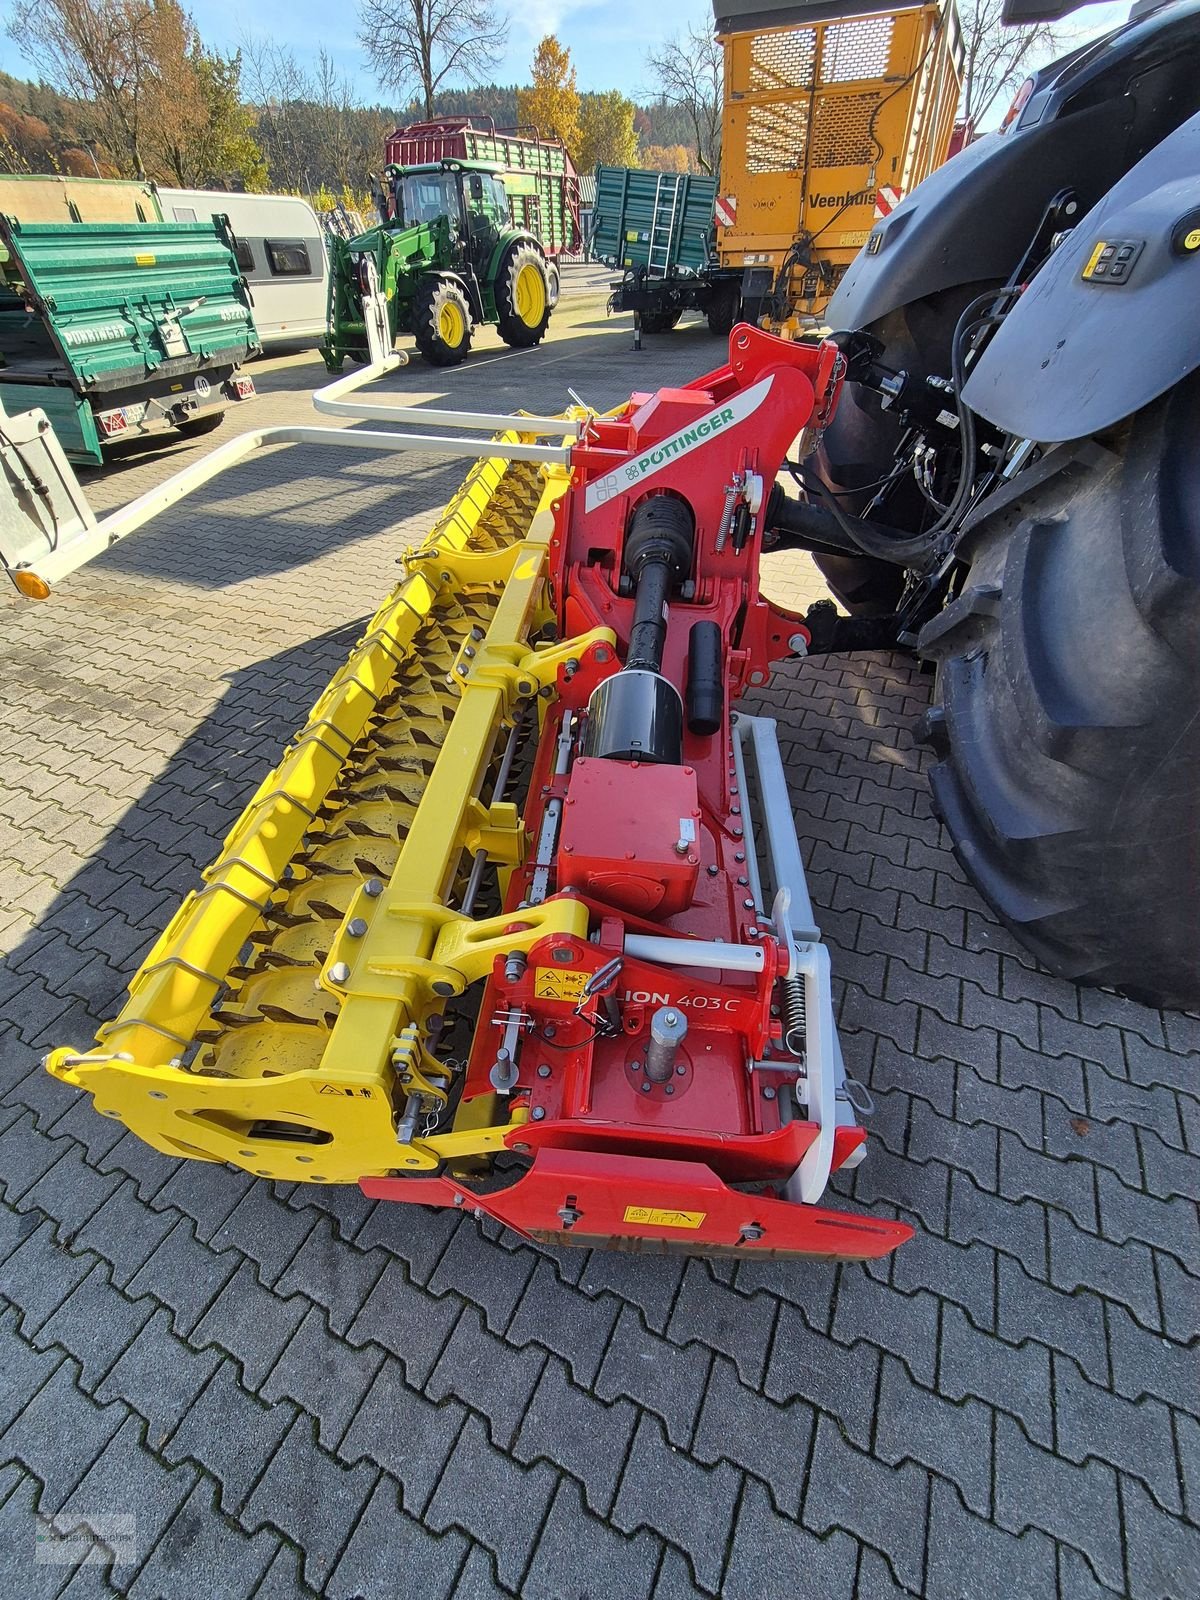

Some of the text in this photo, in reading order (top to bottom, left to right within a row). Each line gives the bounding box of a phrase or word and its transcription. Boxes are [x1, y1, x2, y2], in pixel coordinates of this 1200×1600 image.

[809, 191, 876, 209] Veenhuis
[197, 379, 208, 392] 40
[638, 408, 735, 473] PÖTTINGER
[677, 995, 722, 1010] 403
[724, 999, 740, 1011] C
